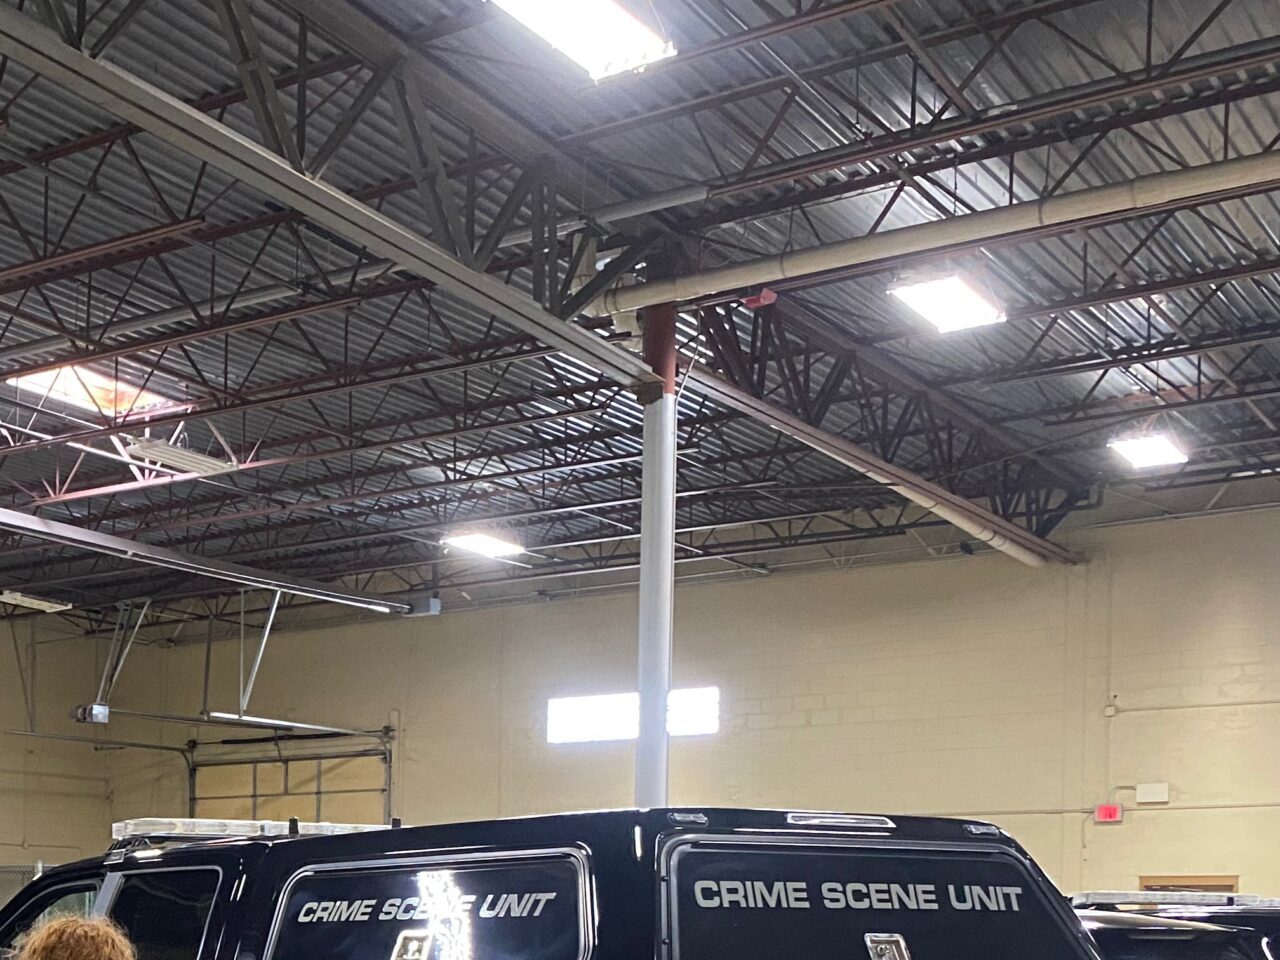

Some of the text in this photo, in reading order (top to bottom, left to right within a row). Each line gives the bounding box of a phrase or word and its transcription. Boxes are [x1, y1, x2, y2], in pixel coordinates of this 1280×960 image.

[298, 893, 557, 923] CRIME SCEE UNIT
[694, 880, 1022, 912] CRIME SCENE UNIT
